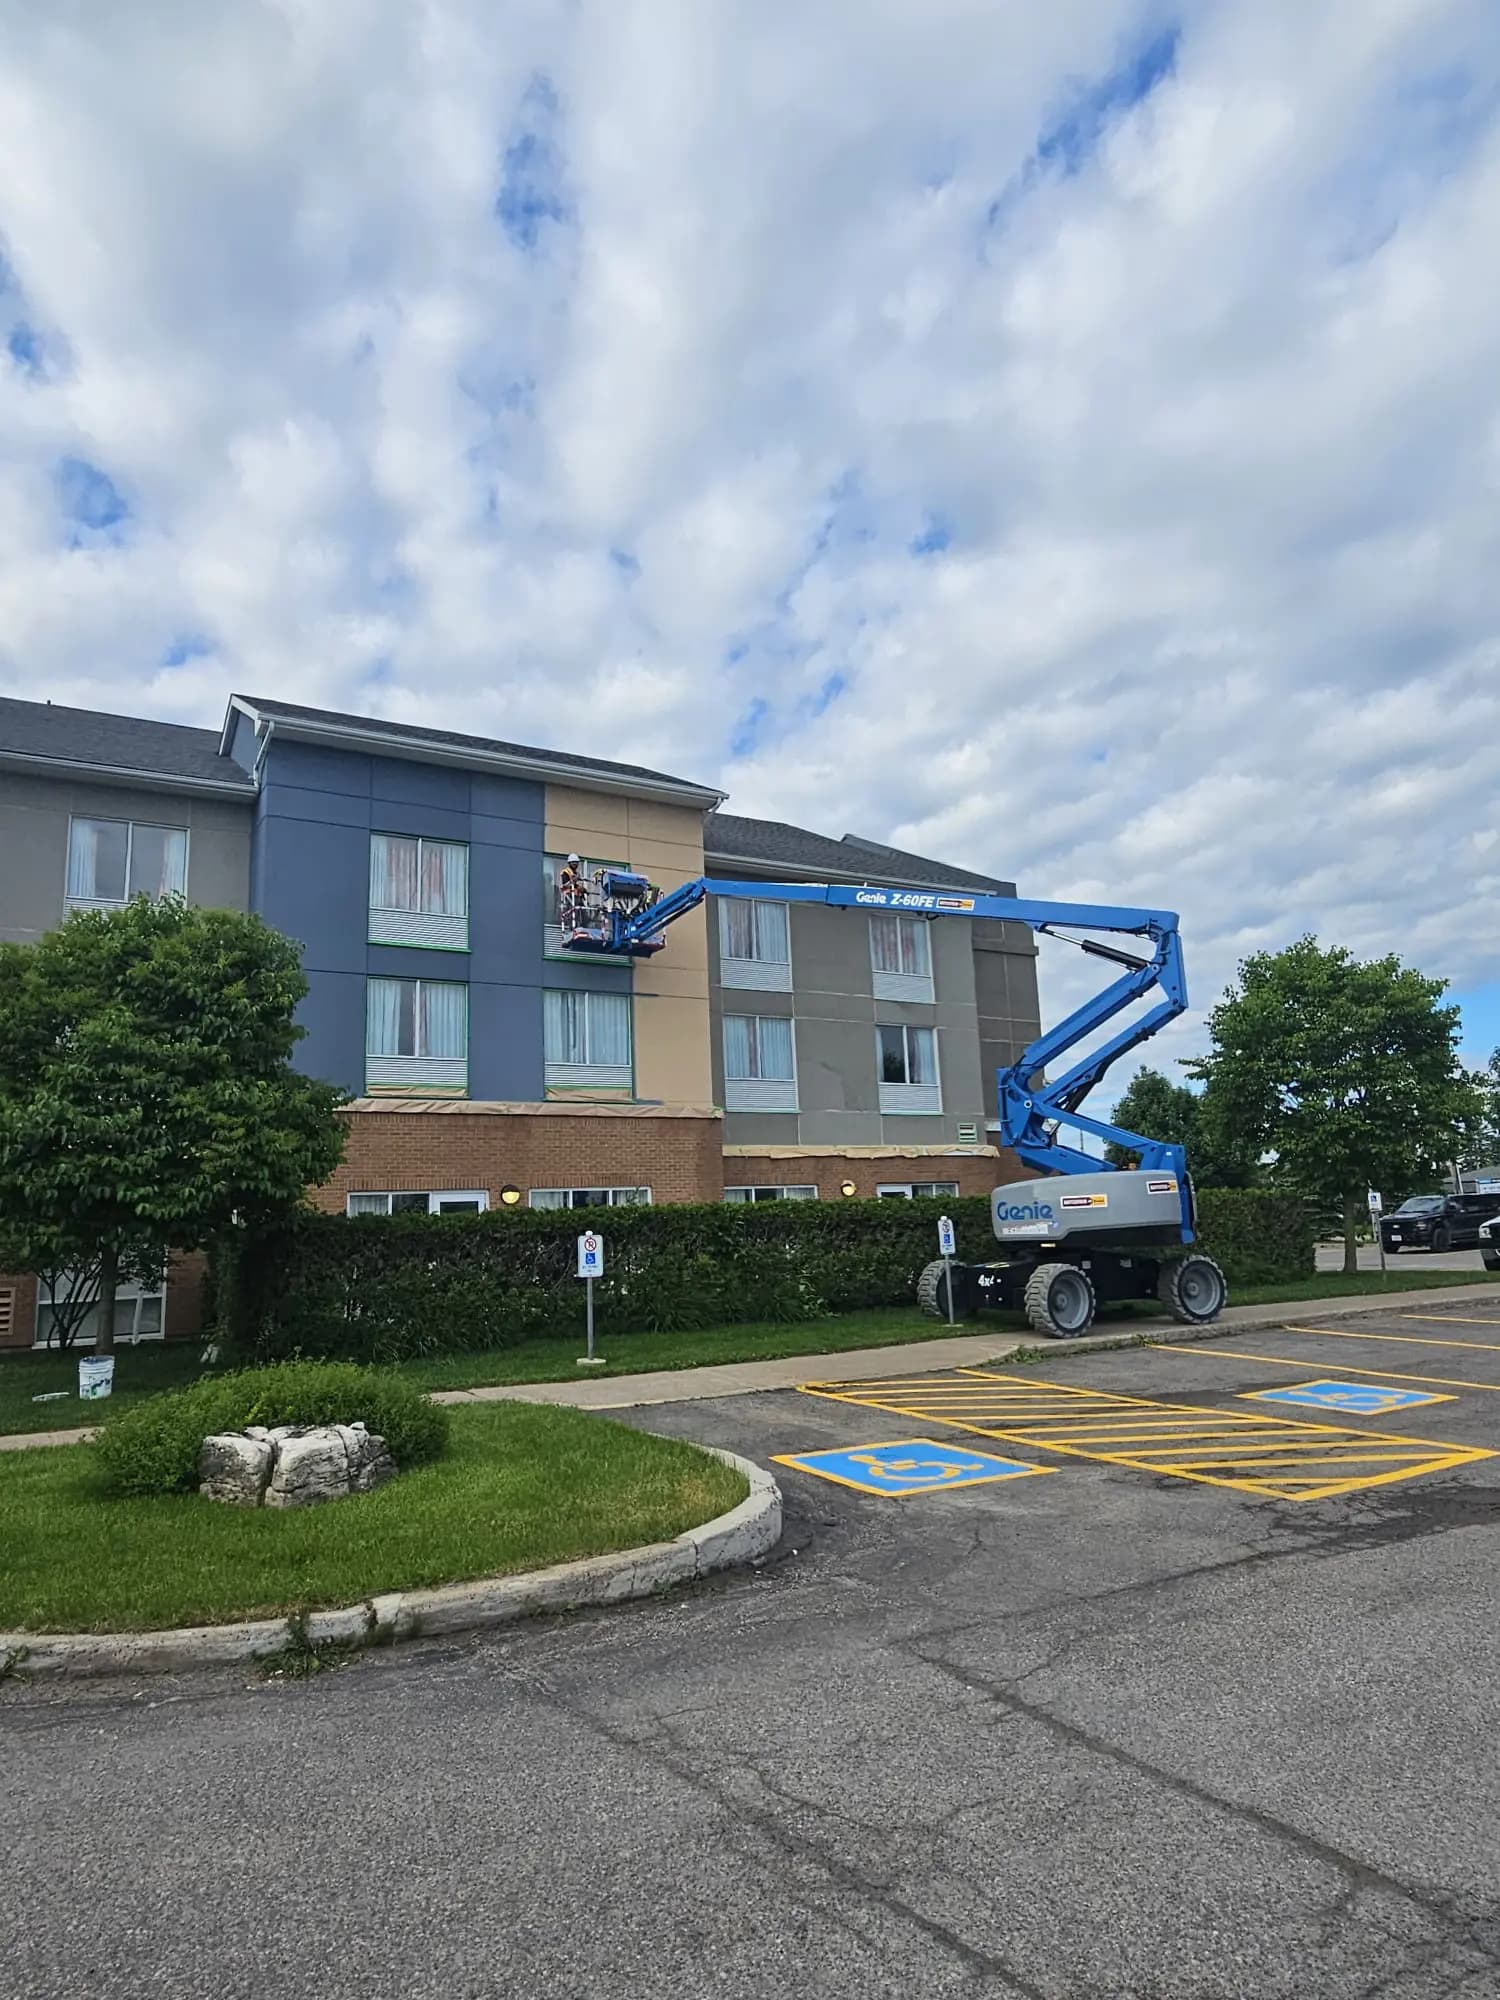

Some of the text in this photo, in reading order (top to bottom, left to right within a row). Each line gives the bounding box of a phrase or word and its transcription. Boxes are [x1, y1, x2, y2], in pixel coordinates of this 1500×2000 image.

[856, 891, 887, 904] Genie
[890, 893, 935, 908] Z-60FE
[997, 1201, 1053, 1221] Genie
